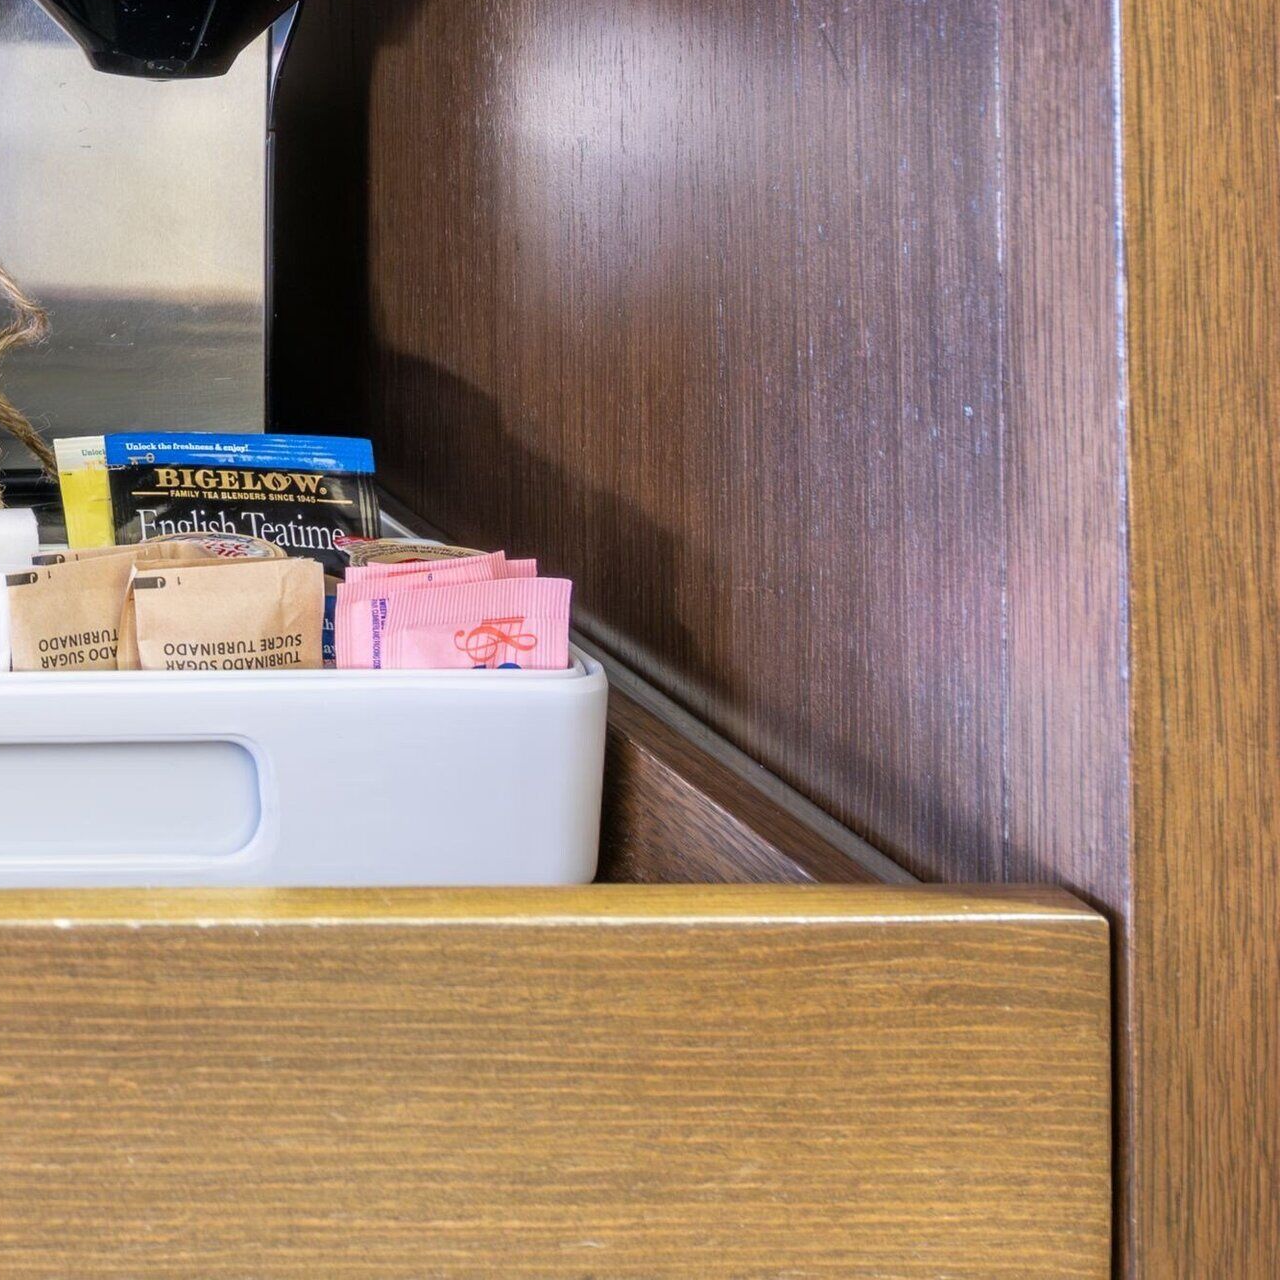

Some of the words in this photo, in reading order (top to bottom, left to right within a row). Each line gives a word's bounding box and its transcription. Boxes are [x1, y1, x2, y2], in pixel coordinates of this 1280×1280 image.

[125, 442, 157, 451] Unlock
[158, 443, 172, 451] the
[173, 442, 214, 451] freshness
[215, 443, 222, 452] &
[222, 444, 249, 454] enjoy!
[170, 489, 199, 498] FAMILY
[202, 491, 219, 499] TEA
[221, 491, 267, 501] BLENDERS
[268, 493, 295, 502] SINCE
[297, 495, 316, 504] 1945
[136, 509, 237, 541] English
[241, 511, 347, 552] Teatime
[39, 628, 118, 652] TURBINADO
[163, 640, 256, 657] TURBINADO
[260, 634, 302, 651] SUCRE
[41, 651, 85, 669] SUGAR
[222, 651, 301, 670] TURBINADO
